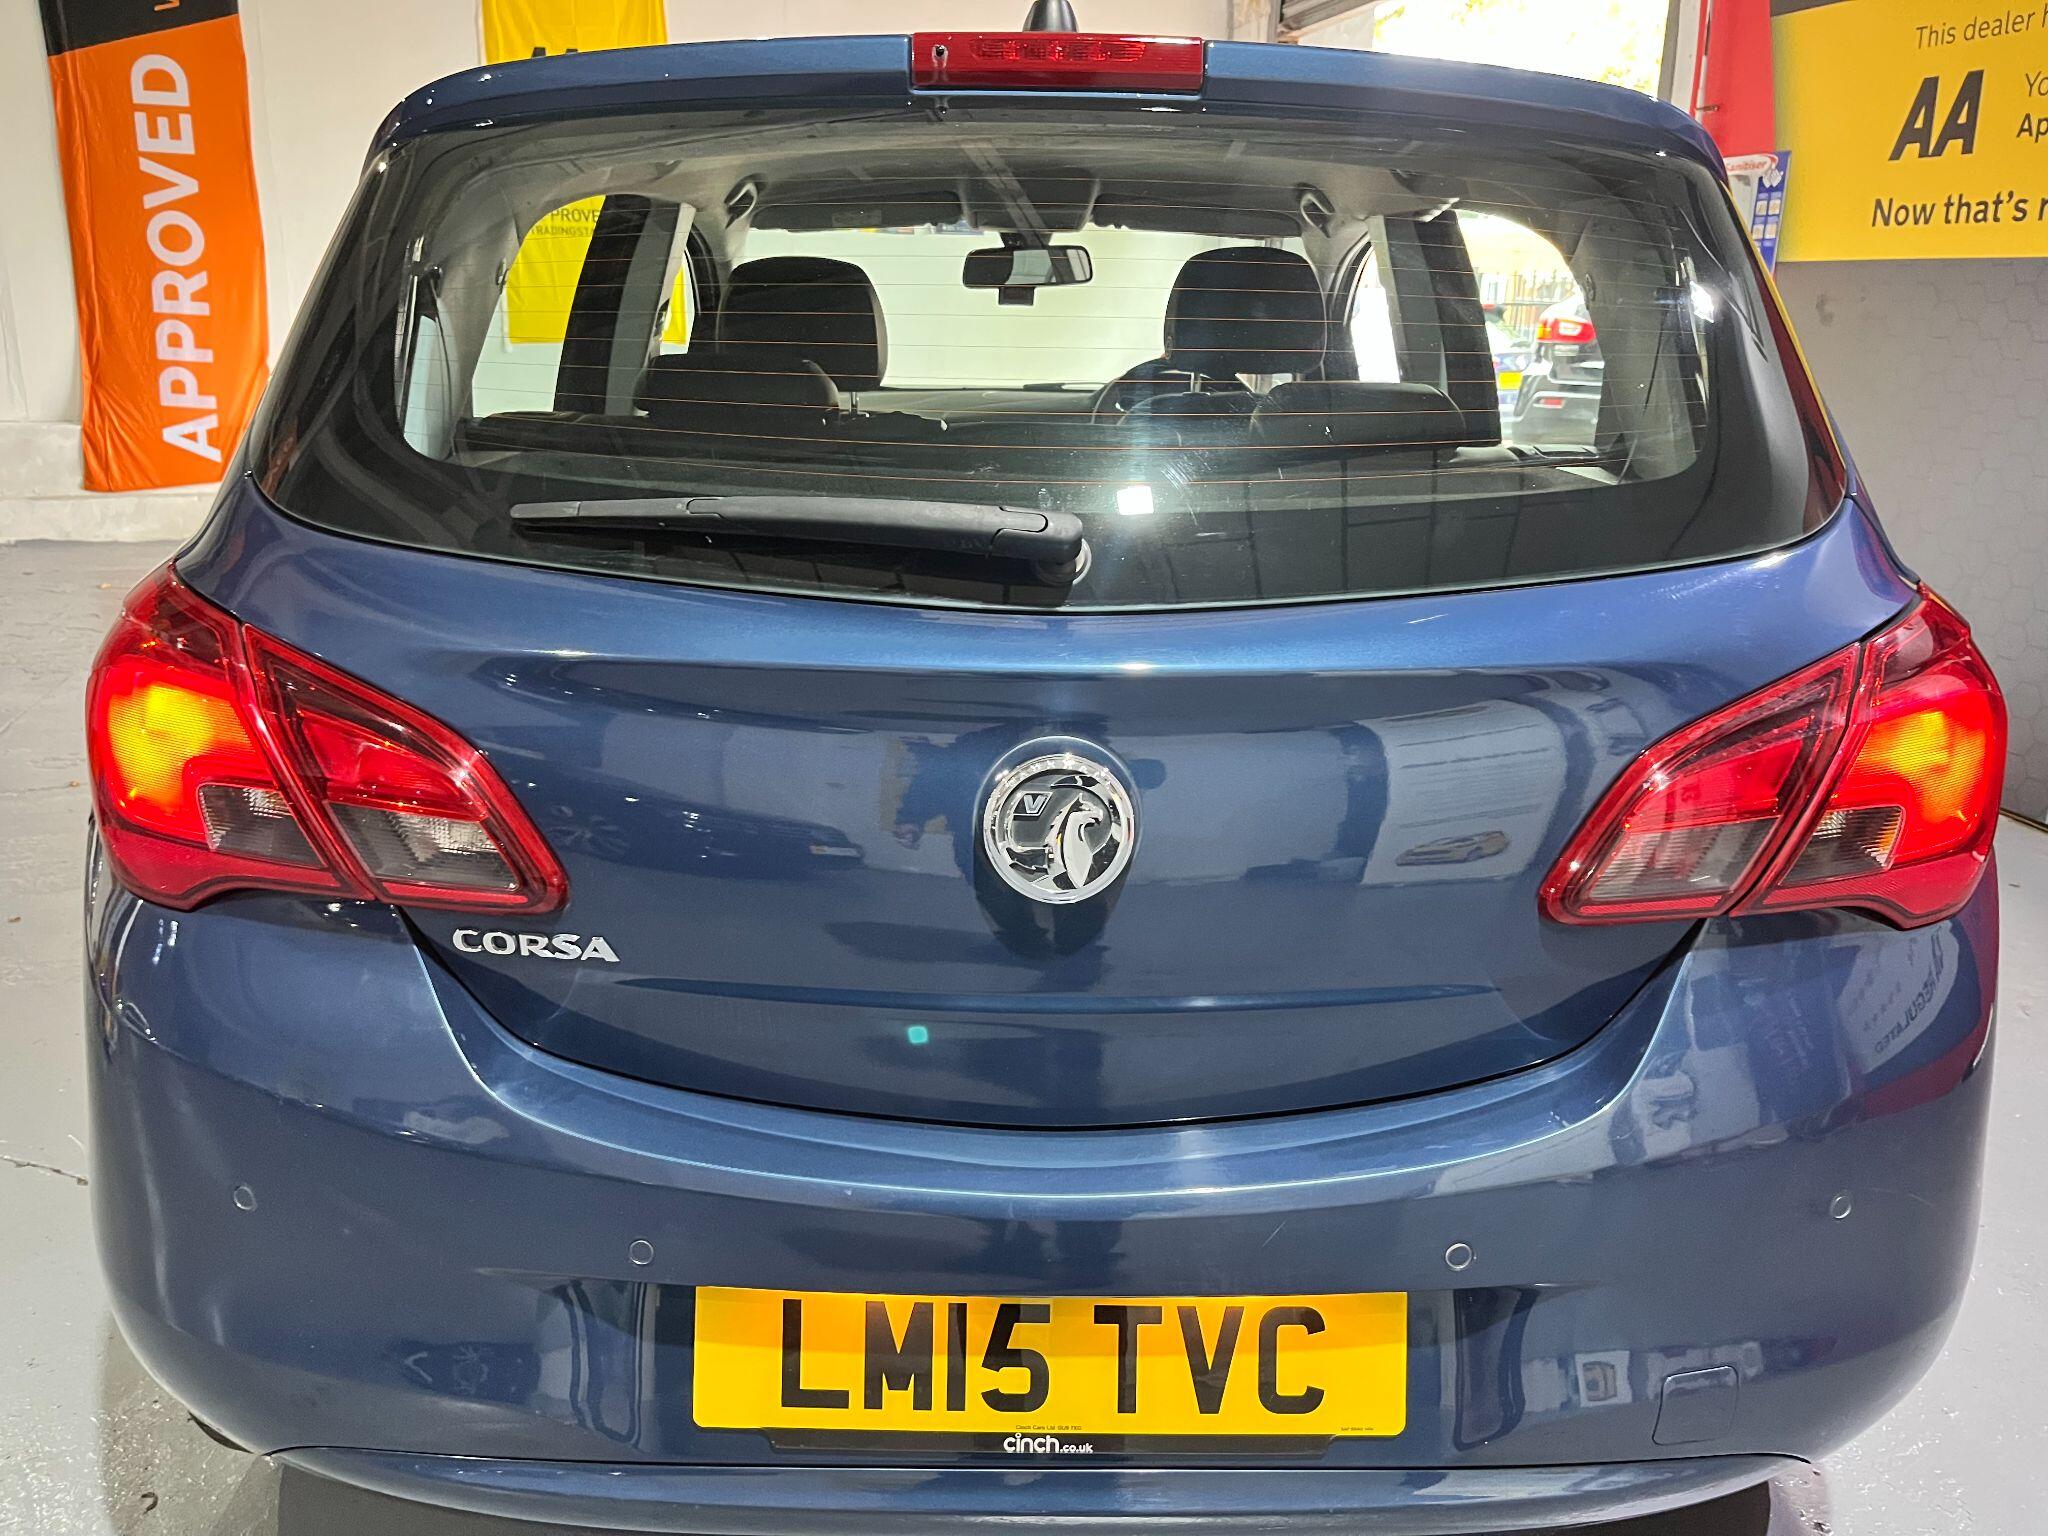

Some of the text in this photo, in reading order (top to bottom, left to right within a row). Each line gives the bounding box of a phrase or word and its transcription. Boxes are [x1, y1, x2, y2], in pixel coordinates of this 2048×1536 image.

[1915, 22, 1957, 49] This
[1963, 10, 2036, 41] dealer
[1888, 69, 1985, 162] AA
[1871, 197, 1936, 227] Now
[1943, 190, 2029, 224] that's
[130, 54, 222, 463] APPROVED
[452, 928, 621, 963] CORSA
[780, 1298, 1326, 1416] LM15 TVC
[1003, 1432, 1093, 1453] cinch.co.uk
